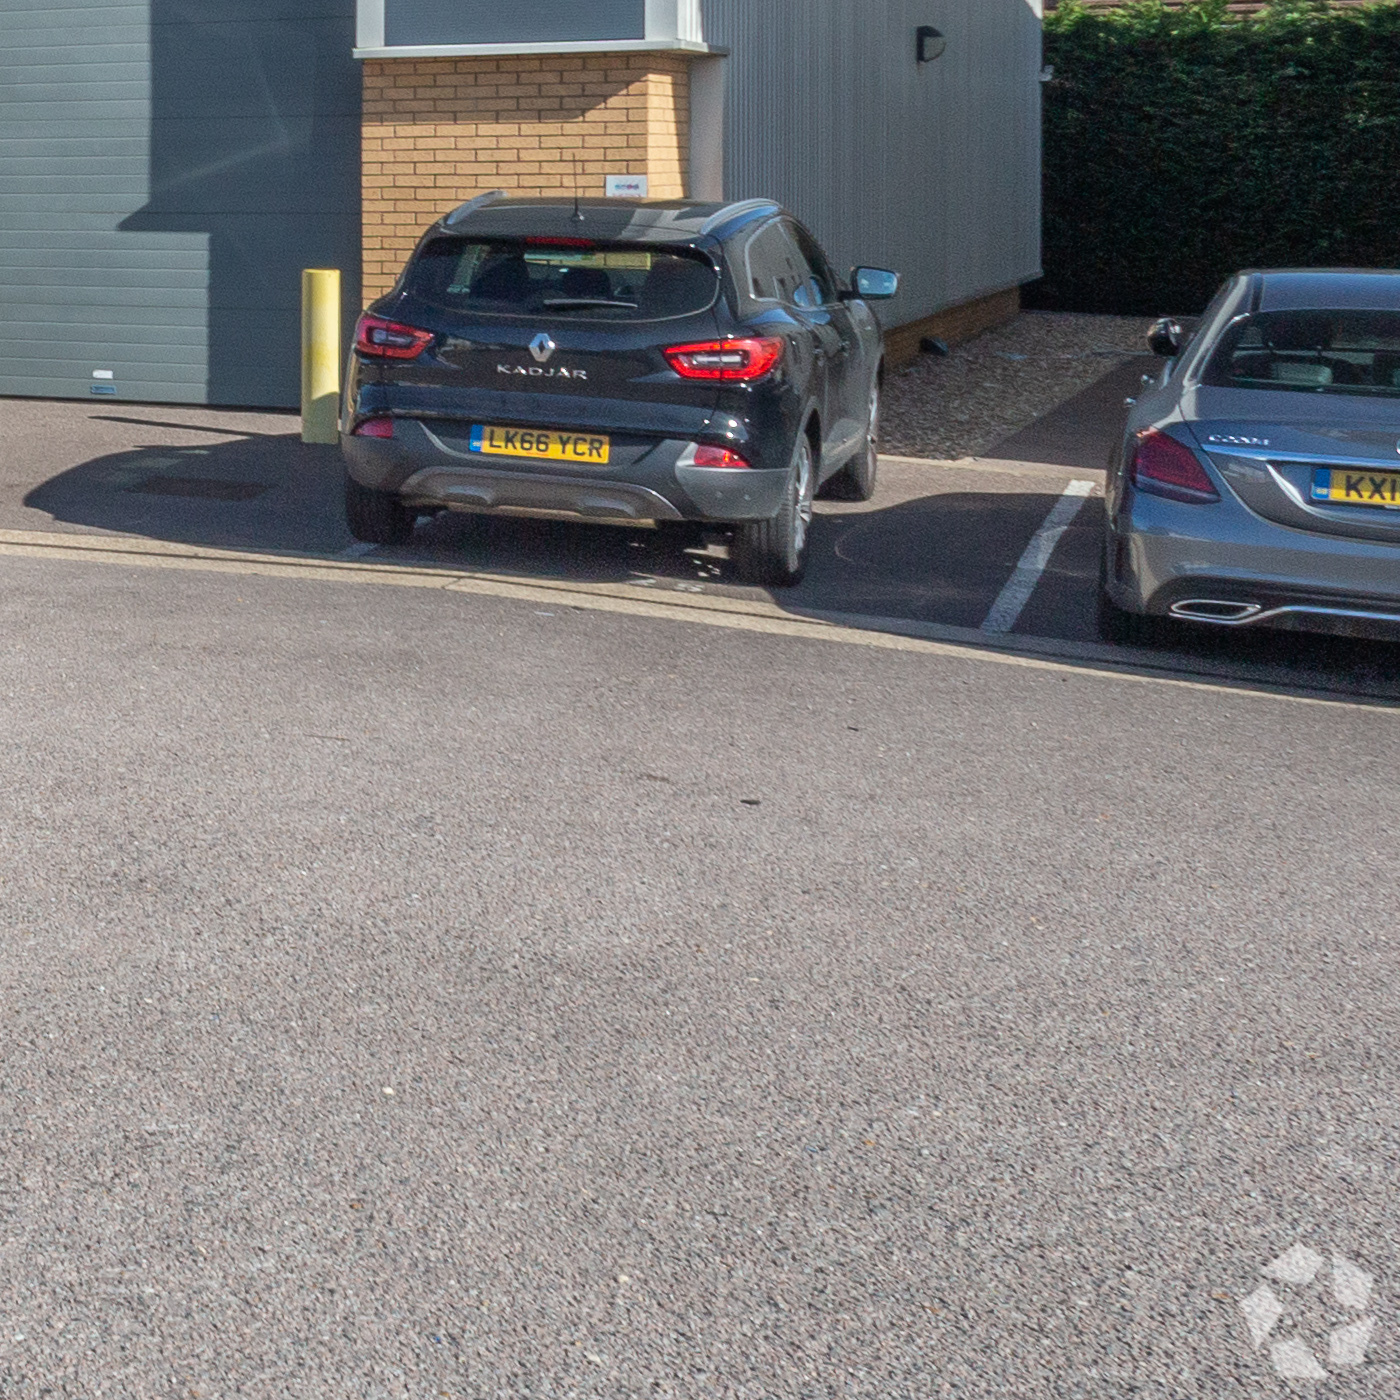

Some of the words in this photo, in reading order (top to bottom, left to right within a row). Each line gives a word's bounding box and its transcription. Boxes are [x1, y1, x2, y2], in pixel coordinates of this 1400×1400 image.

[496, 363, 588, 380] KADJAR
[488, 429, 549, 453] LK66
[558, 435, 603, 458] YCR
